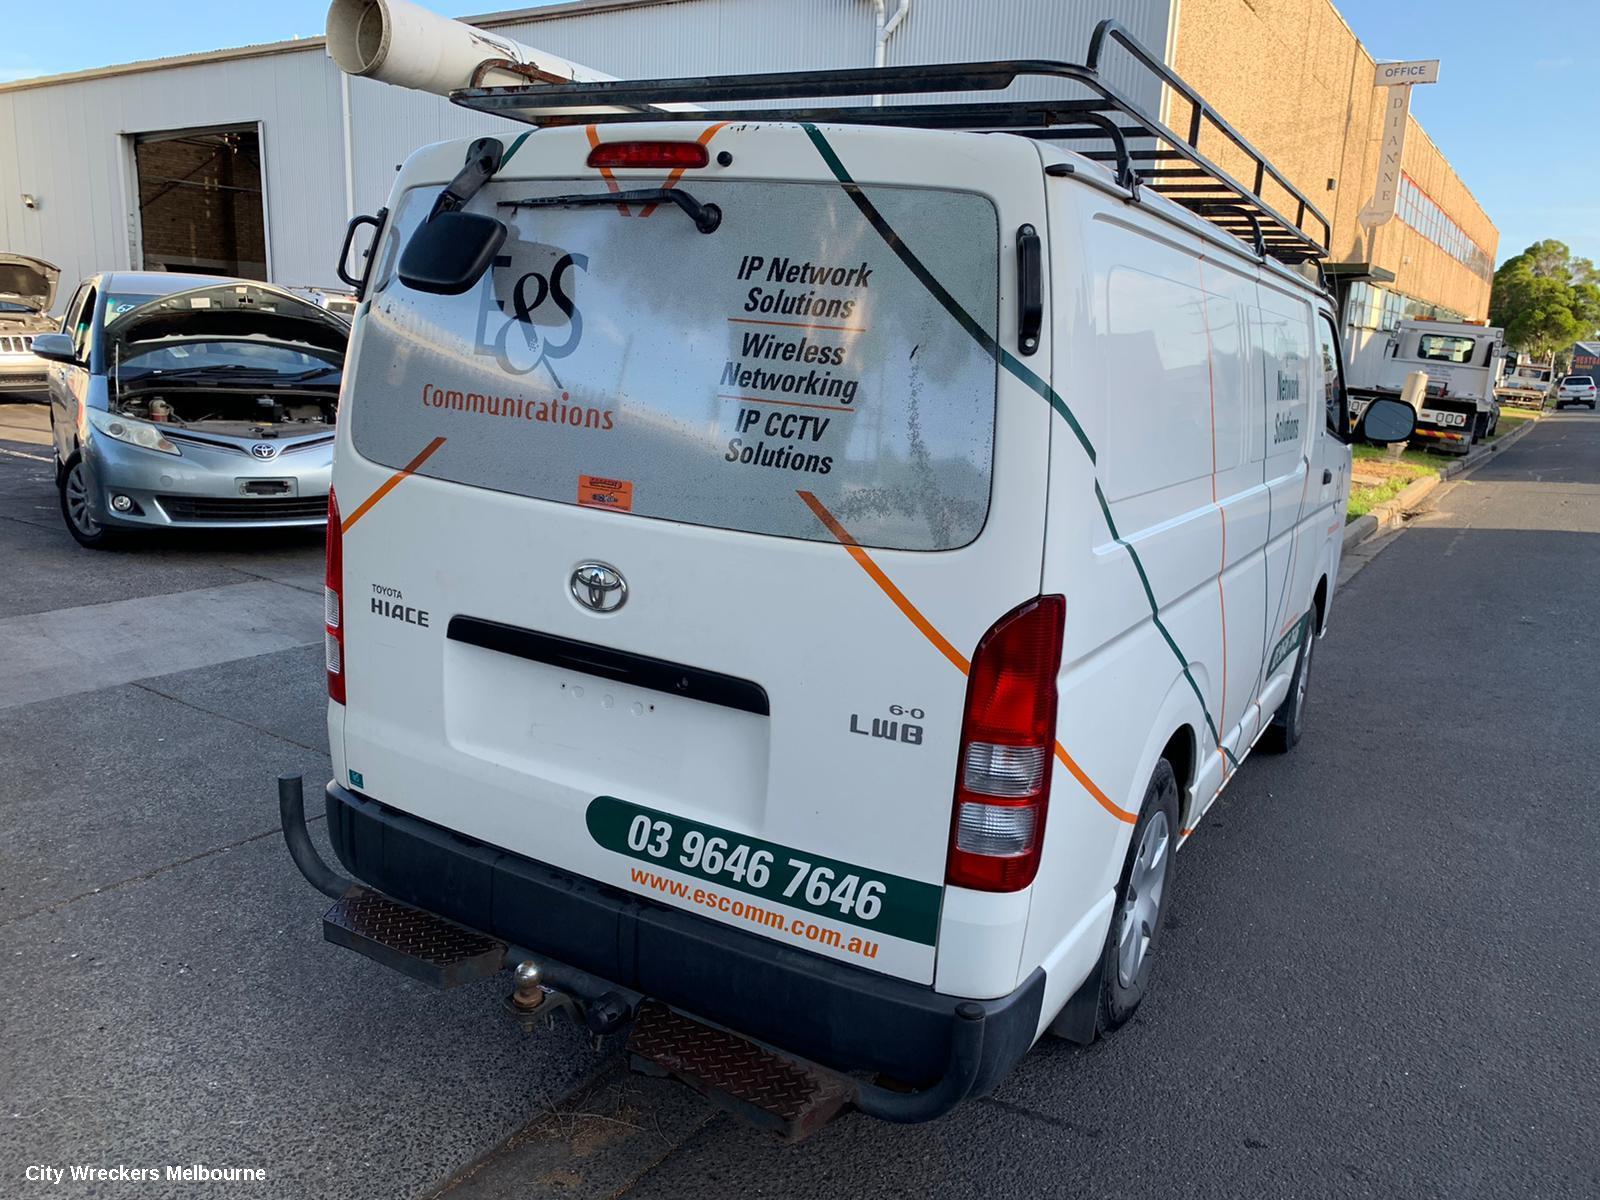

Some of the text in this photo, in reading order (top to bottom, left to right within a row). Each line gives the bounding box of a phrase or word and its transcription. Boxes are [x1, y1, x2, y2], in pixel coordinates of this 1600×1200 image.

[1385, 66, 1425, 78] OFFICE
[1382, 97, 1403, 201] DIANNE
[737, 255, 873, 288] IP Network
[744, 287, 856, 319] Solutions
[741, 332, 846, 366] Wireless
[720, 361, 858, 404] Networking
[422, 383, 614, 430] Communications
[734, 408, 830, 442] IP CCTV
[725, 438, 833, 475] Solutions
[372, 583, 402, 599] TOYOTA
[371, 597, 429, 628] HIACE
[850, 714, 923, 745] LWB
[627, 814, 887, 921] 03 9646 7646
[630, 867, 879, 959] www.escomm.com.au
